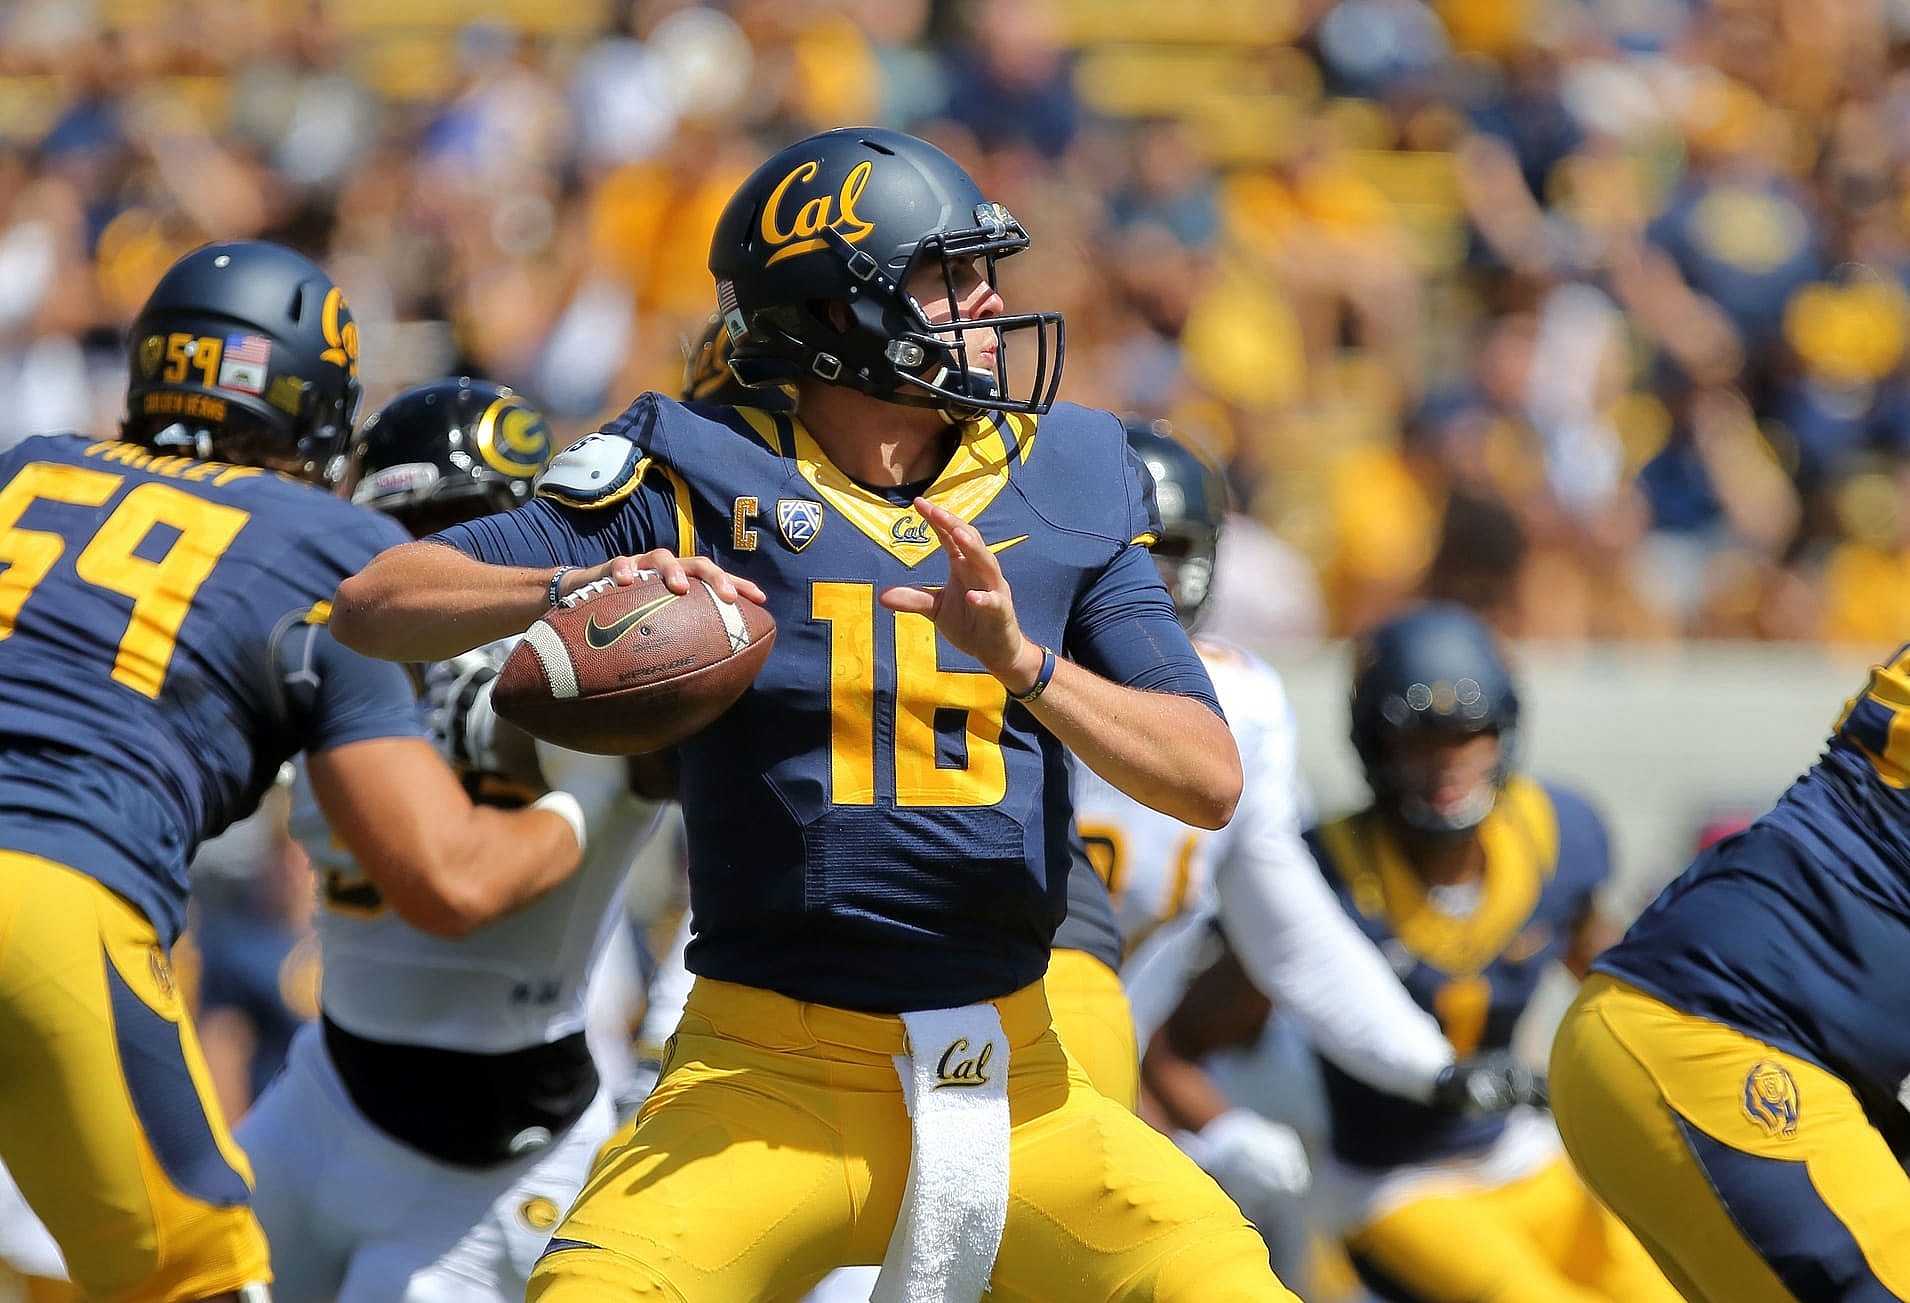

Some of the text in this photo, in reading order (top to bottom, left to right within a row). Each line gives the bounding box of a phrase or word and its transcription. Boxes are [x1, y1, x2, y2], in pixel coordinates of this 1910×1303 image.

[760, 159, 876, 269] Cal
[162, 332, 224, 390] 59
[733, 496, 758, 551] C
[780, 501, 820, 529] PAC
[787, 520, 811, 539] 12
[890, 515, 932, 545] Cal
[0, 459, 251, 700] 59
[811, 581, 1008, 807] 16
[932, 1037, 993, 1092] Cal
